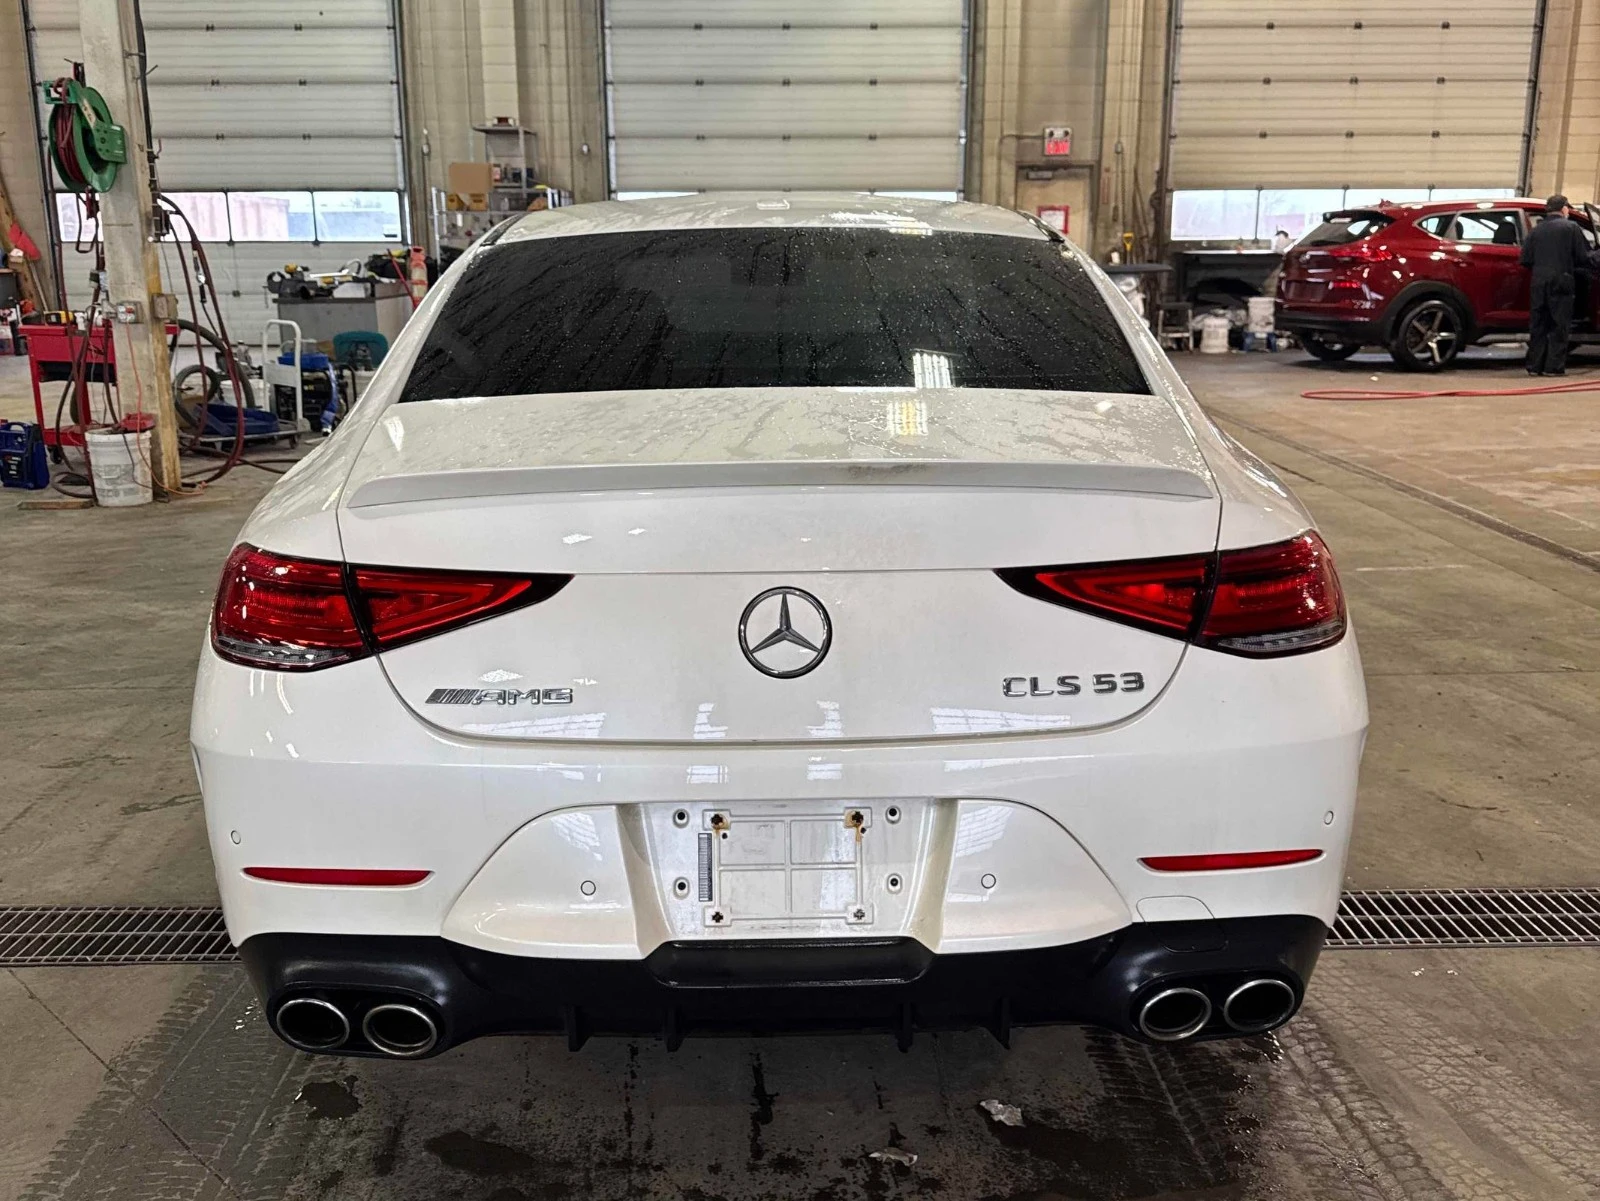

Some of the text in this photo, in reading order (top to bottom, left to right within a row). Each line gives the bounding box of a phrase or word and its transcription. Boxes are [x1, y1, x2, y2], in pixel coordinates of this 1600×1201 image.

[1003, 672, 1145, 697] CLS 53
[471, 688, 574, 705] AMG
